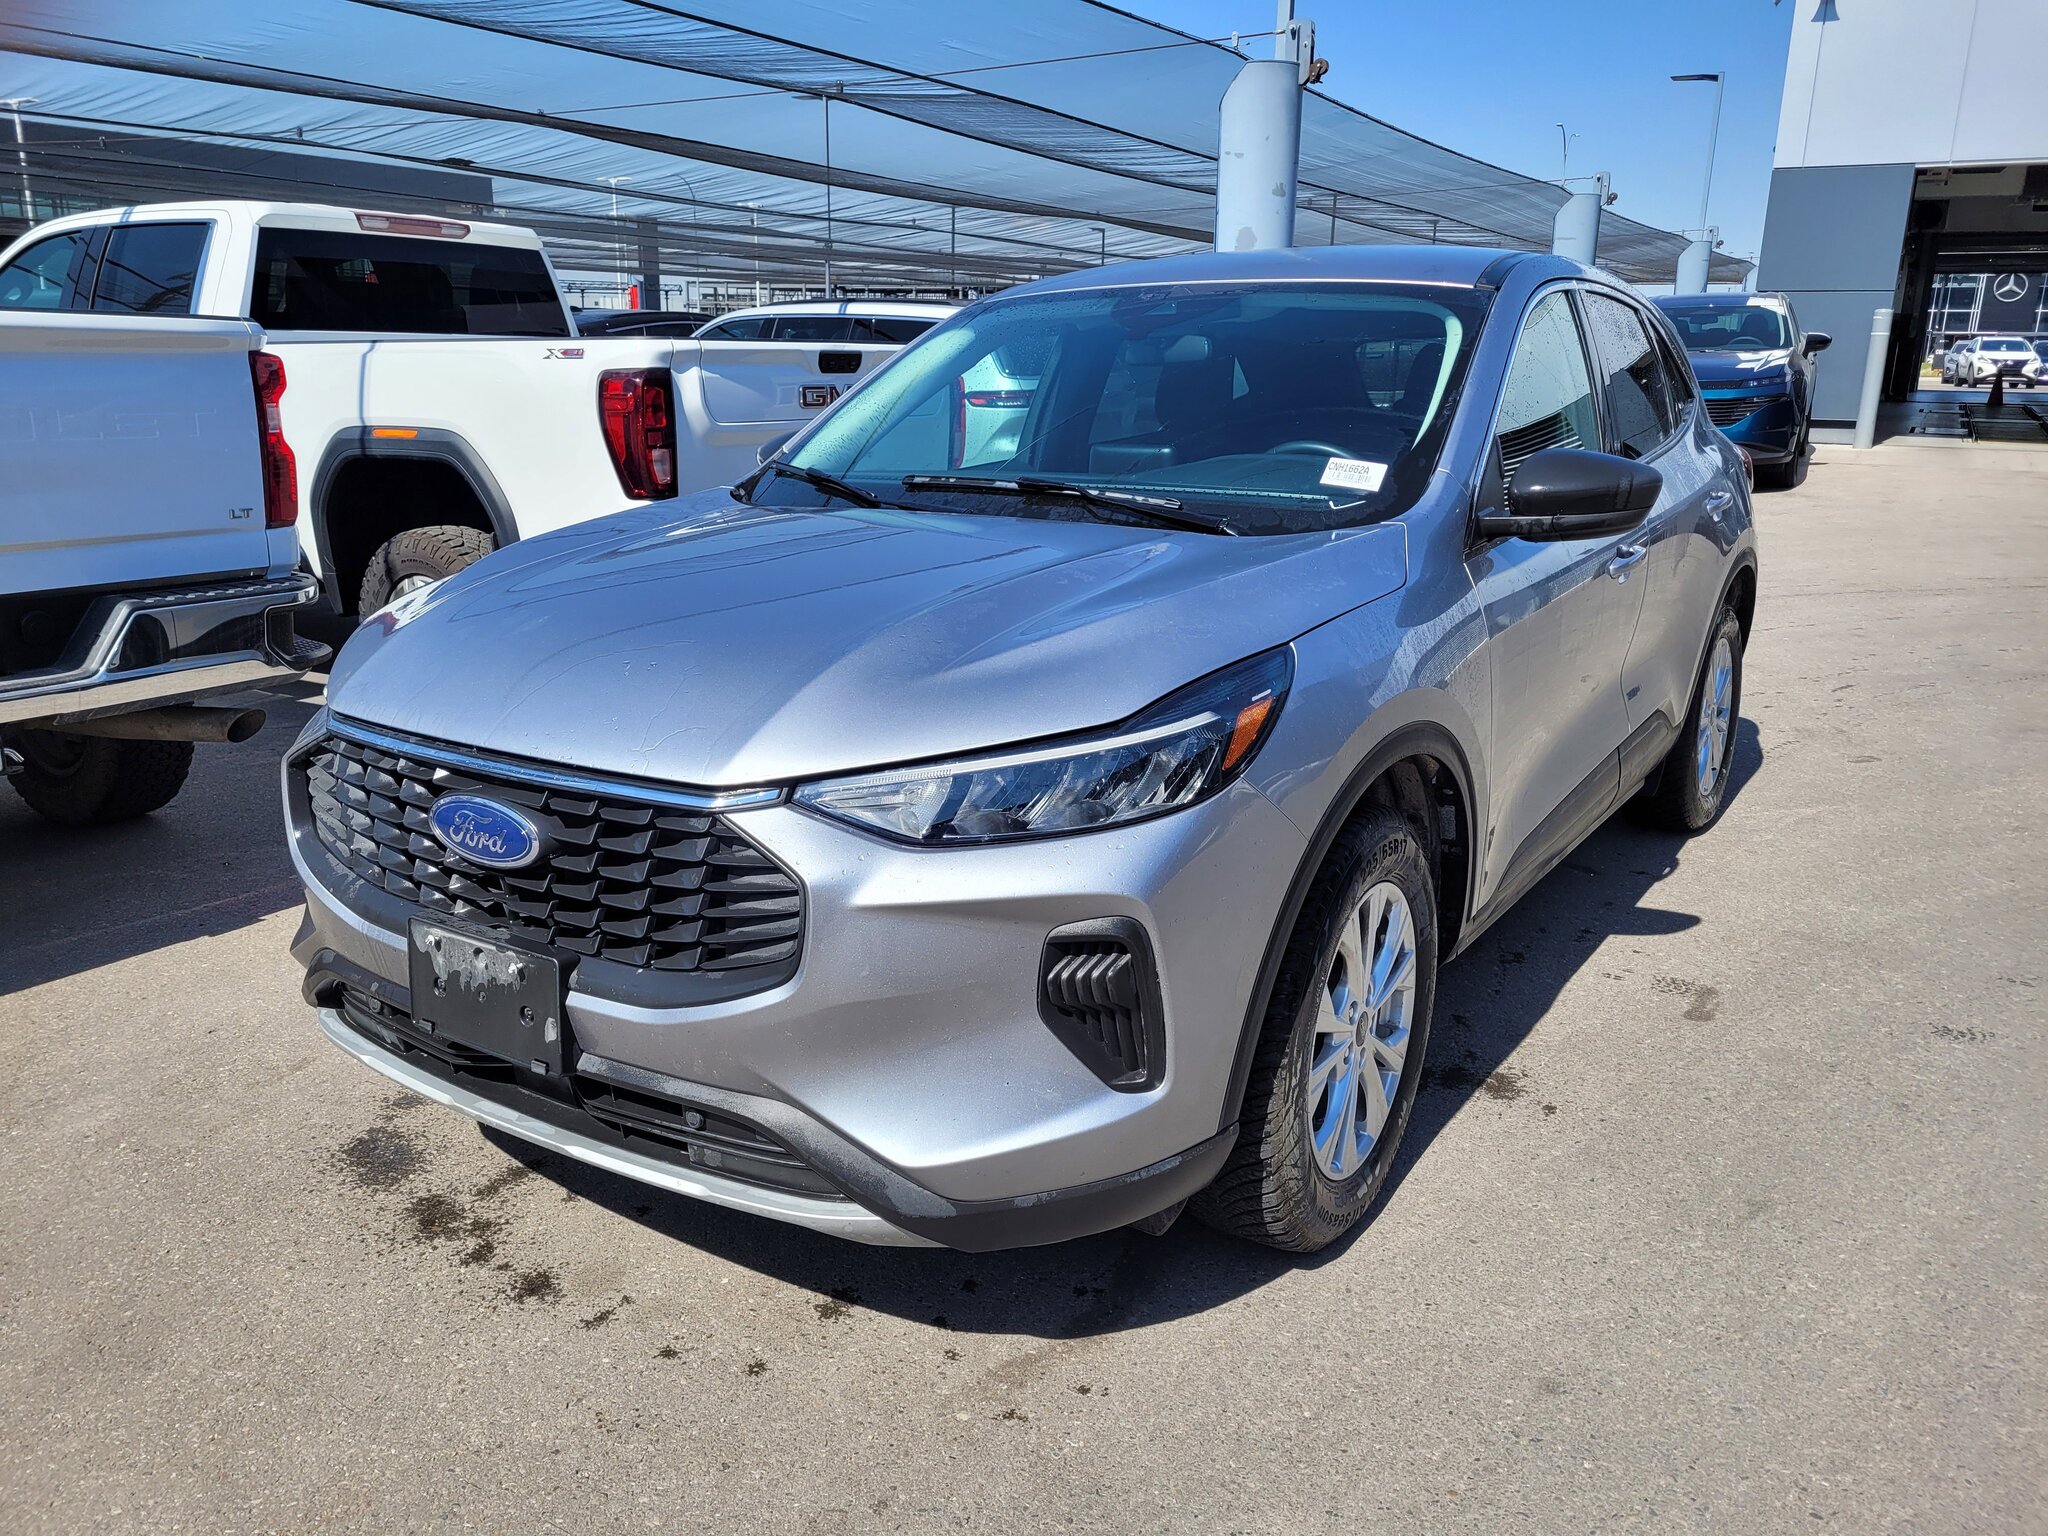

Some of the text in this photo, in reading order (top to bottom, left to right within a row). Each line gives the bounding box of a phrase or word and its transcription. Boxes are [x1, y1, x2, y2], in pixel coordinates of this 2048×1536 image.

[1328, 461, 1370, 475] CNH1662A
[229, 508, 254, 519] LT
[449, 809, 507, 854] Ford
